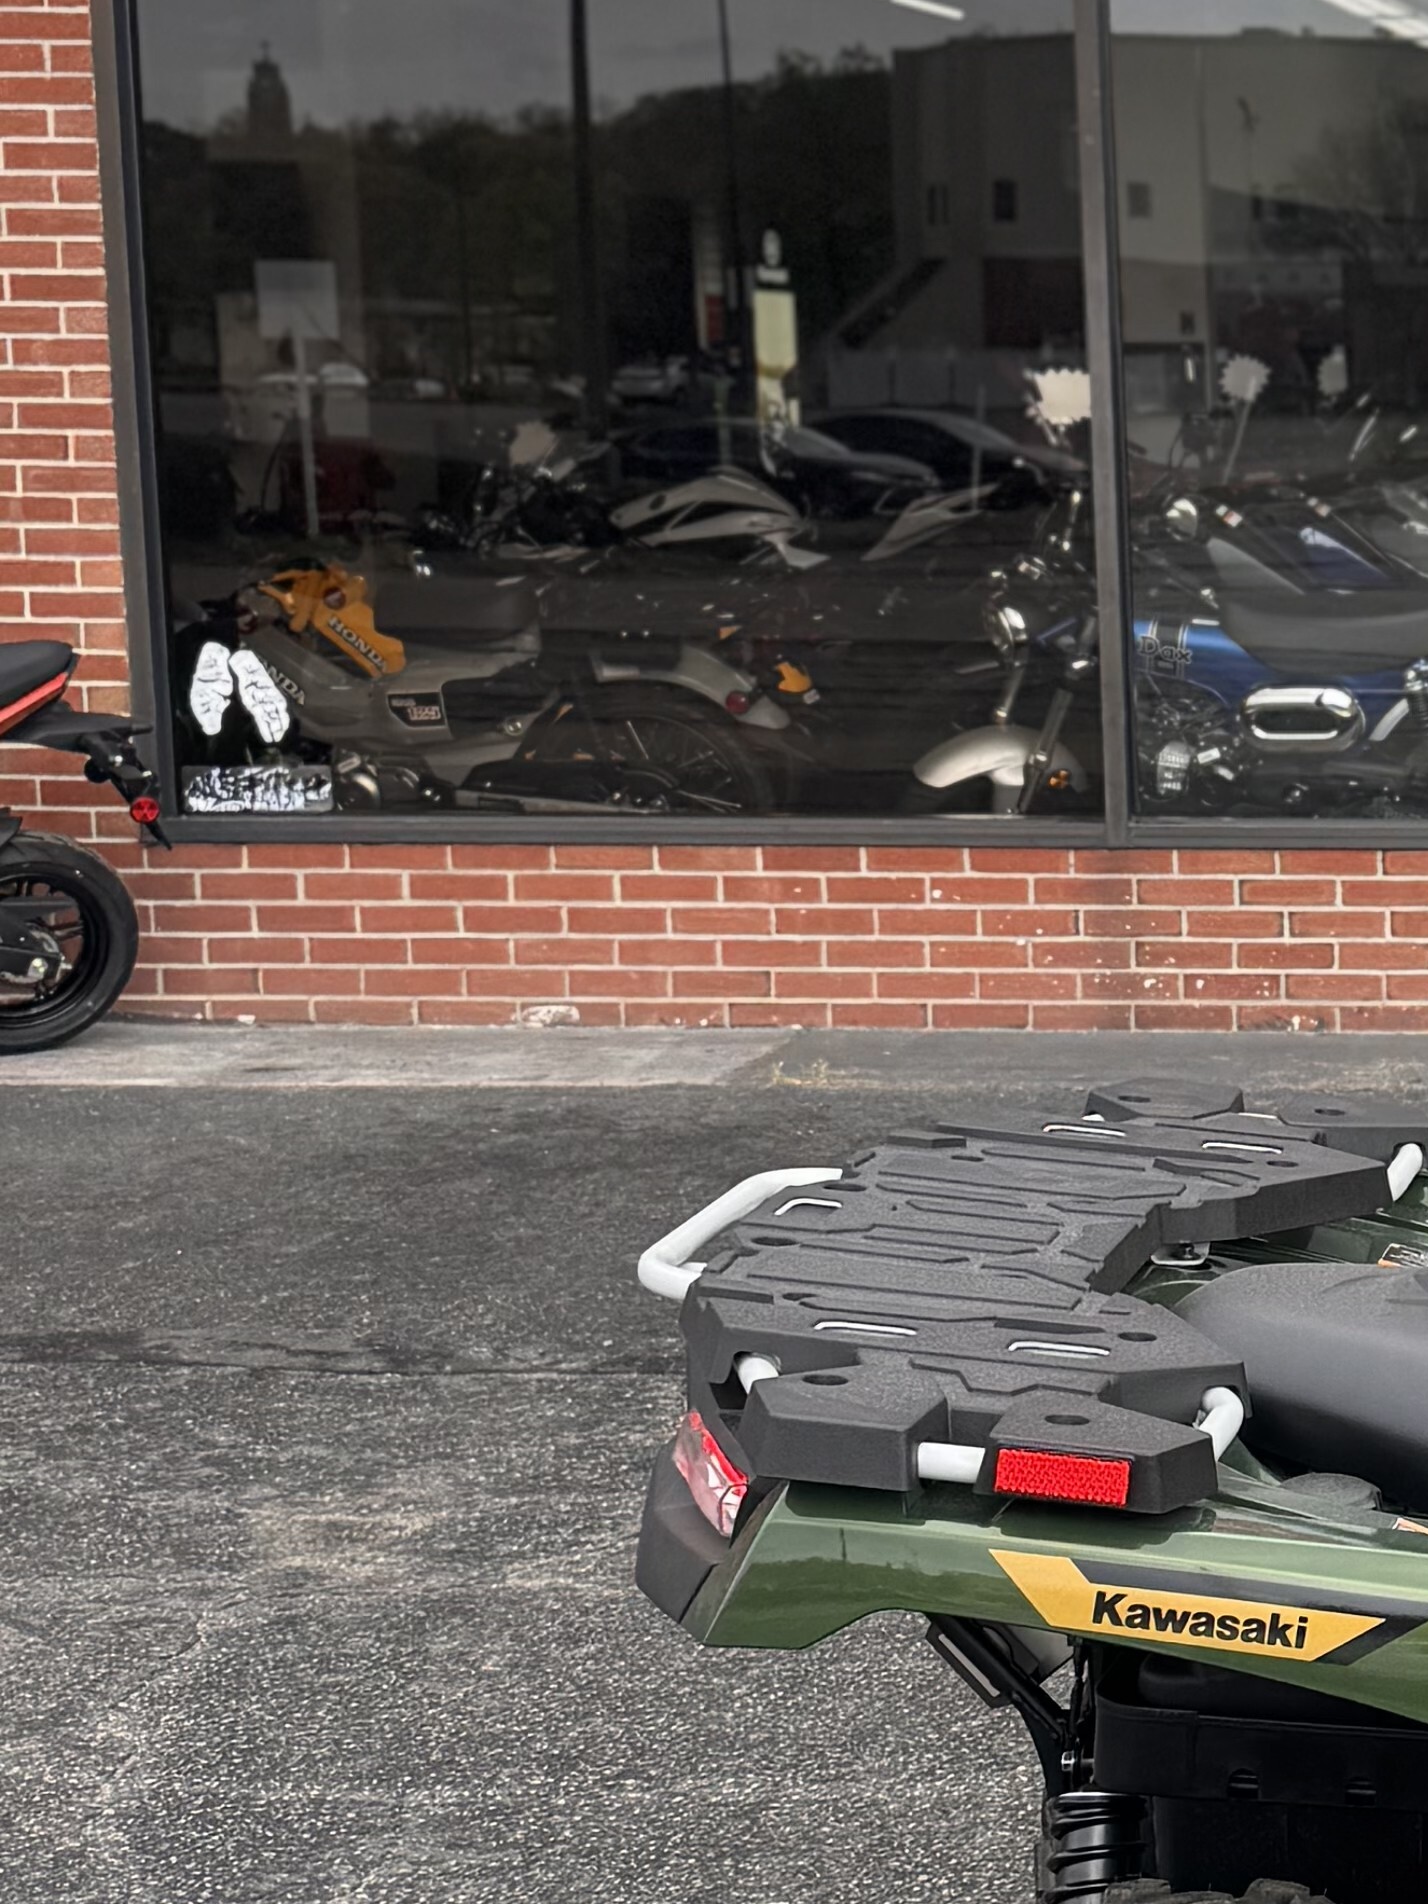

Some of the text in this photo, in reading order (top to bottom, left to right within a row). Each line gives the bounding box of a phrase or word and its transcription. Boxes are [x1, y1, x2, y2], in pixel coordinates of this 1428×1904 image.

[327, 615, 388, 673] HONDA
[1137, 634, 1194, 665] Dax
[1091, 1590, 1309, 1649] Kawasaki
